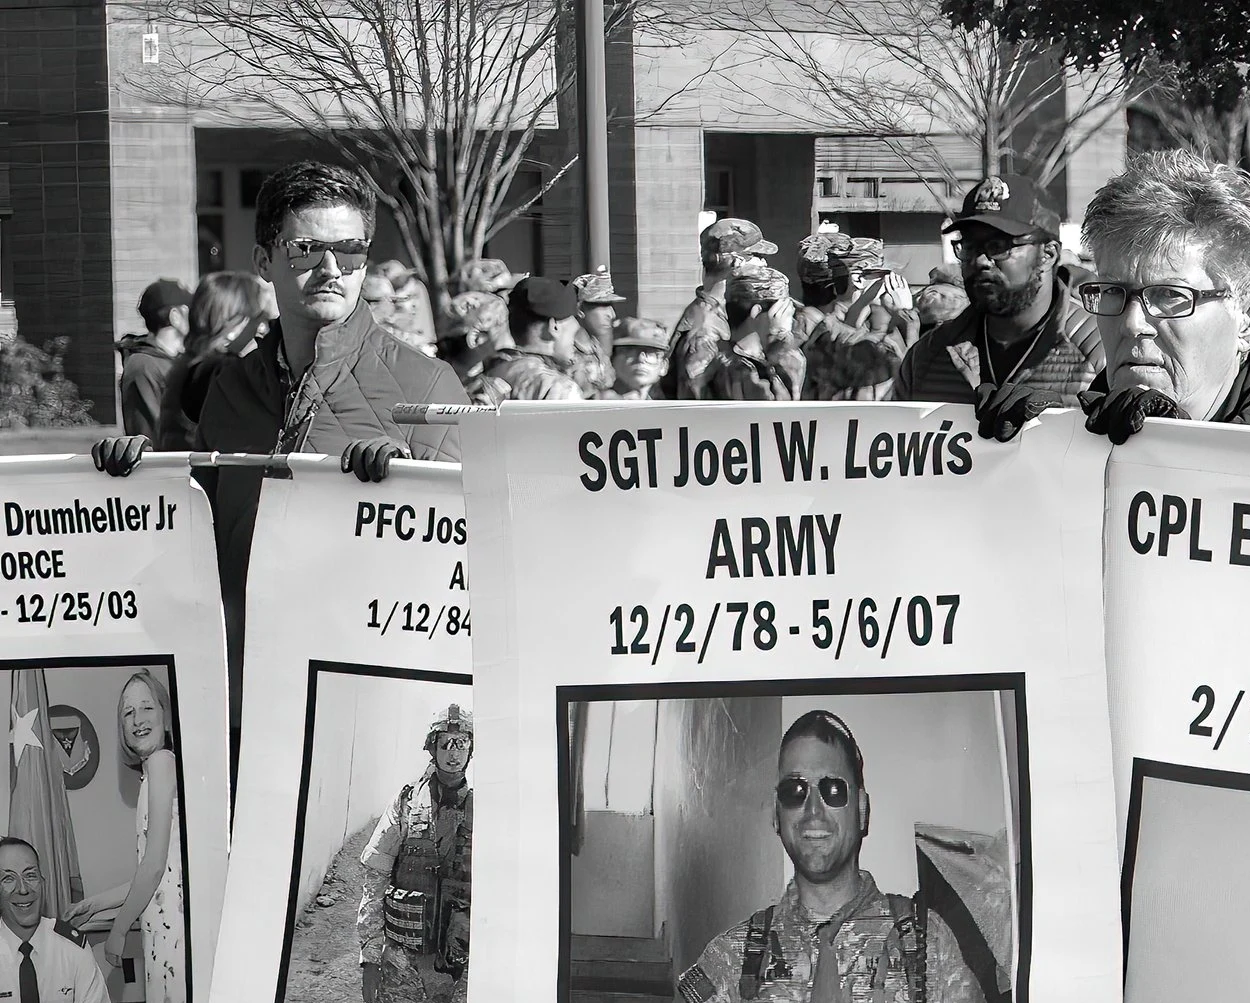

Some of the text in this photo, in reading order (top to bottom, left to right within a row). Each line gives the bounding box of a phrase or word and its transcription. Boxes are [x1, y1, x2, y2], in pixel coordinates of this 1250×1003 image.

[579, 419, 972, 491] SGT Joel W. Lewis
[5, 496, 176, 536] Drumheller Jr
[355, 502, 415, 540] PFC
[1128, 491, 1212, 562] CPL
[1, 550, 65, 580] ORCE
[706, 514, 841, 578] ARMY
[448, 560, 469, 591] A
[16, 590, 137, 628] 12/25/03
[610, 601, 777, 665] 12/2/78
[812, 595, 959, 659] 5/6/07
